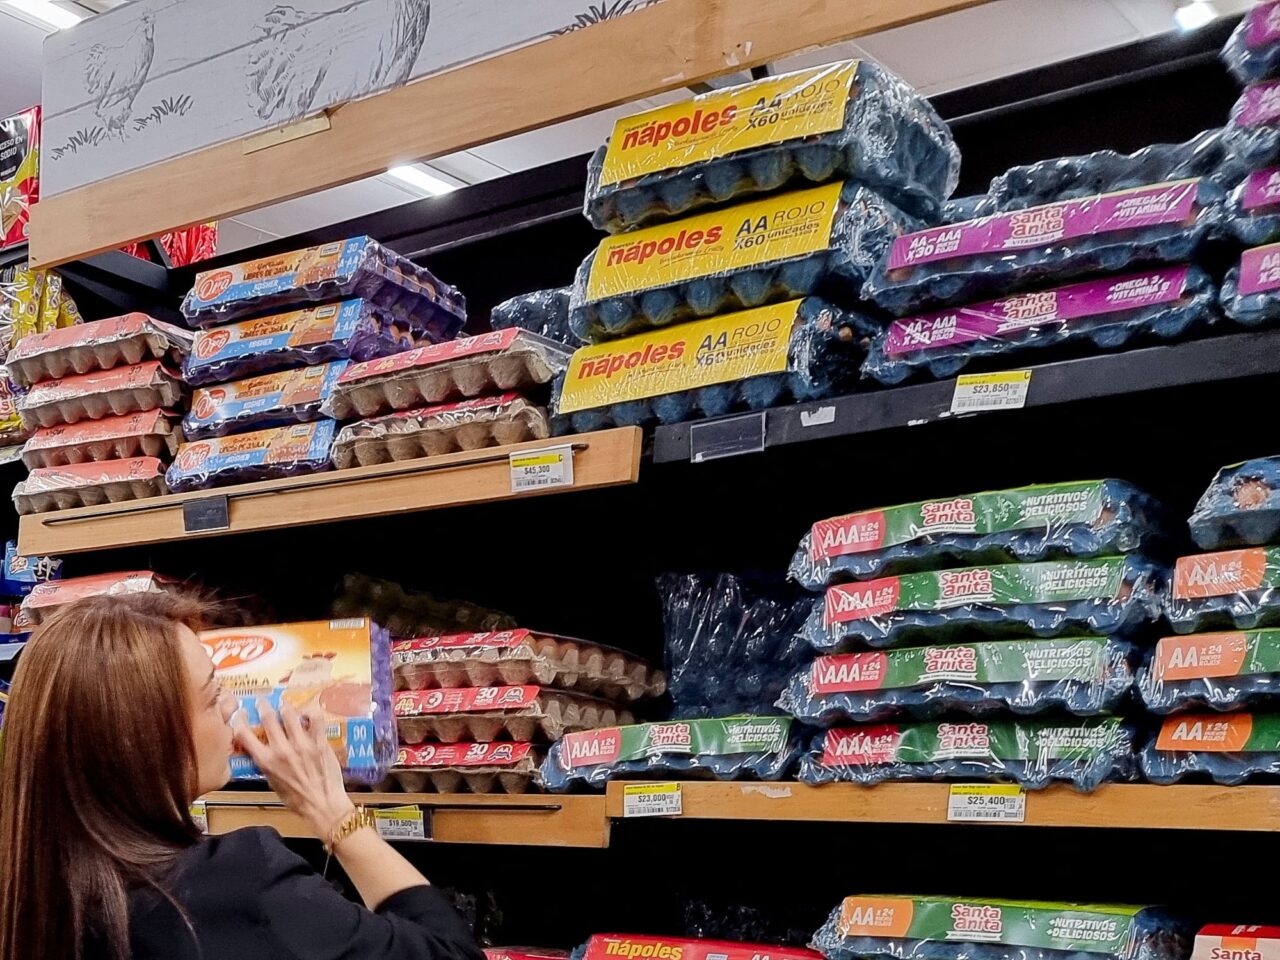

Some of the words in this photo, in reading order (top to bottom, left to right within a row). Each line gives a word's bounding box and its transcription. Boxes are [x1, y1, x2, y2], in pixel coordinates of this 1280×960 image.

[621, 104, 738, 150] nápoles
[0, 147, 17, 161] SODIO
[772, 201, 825, 224] ROJO
[1012, 217, 1063, 238] anita
[606, 225, 723, 267] nápoles
[731, 317, 782, 340] ROJO
[577, 339, 687, 380] nápoles
[972, 382, 1009, 395] $23,850
[923, 509, 974, 527] anita
[824, 525, 859, 547] AAA
[943, 579, 992, 597] anita
[1168, 647, 1198, 668] AA
[940, 732, 988, 749] anita
[1172, 722, 1203, 741] AA
[967, 795, 1005, 806] $25,400
[952, 904, 999, 919] Santa
[954, 916, 1002, 931] anita
[606, 940, 683, 960] nápoles
